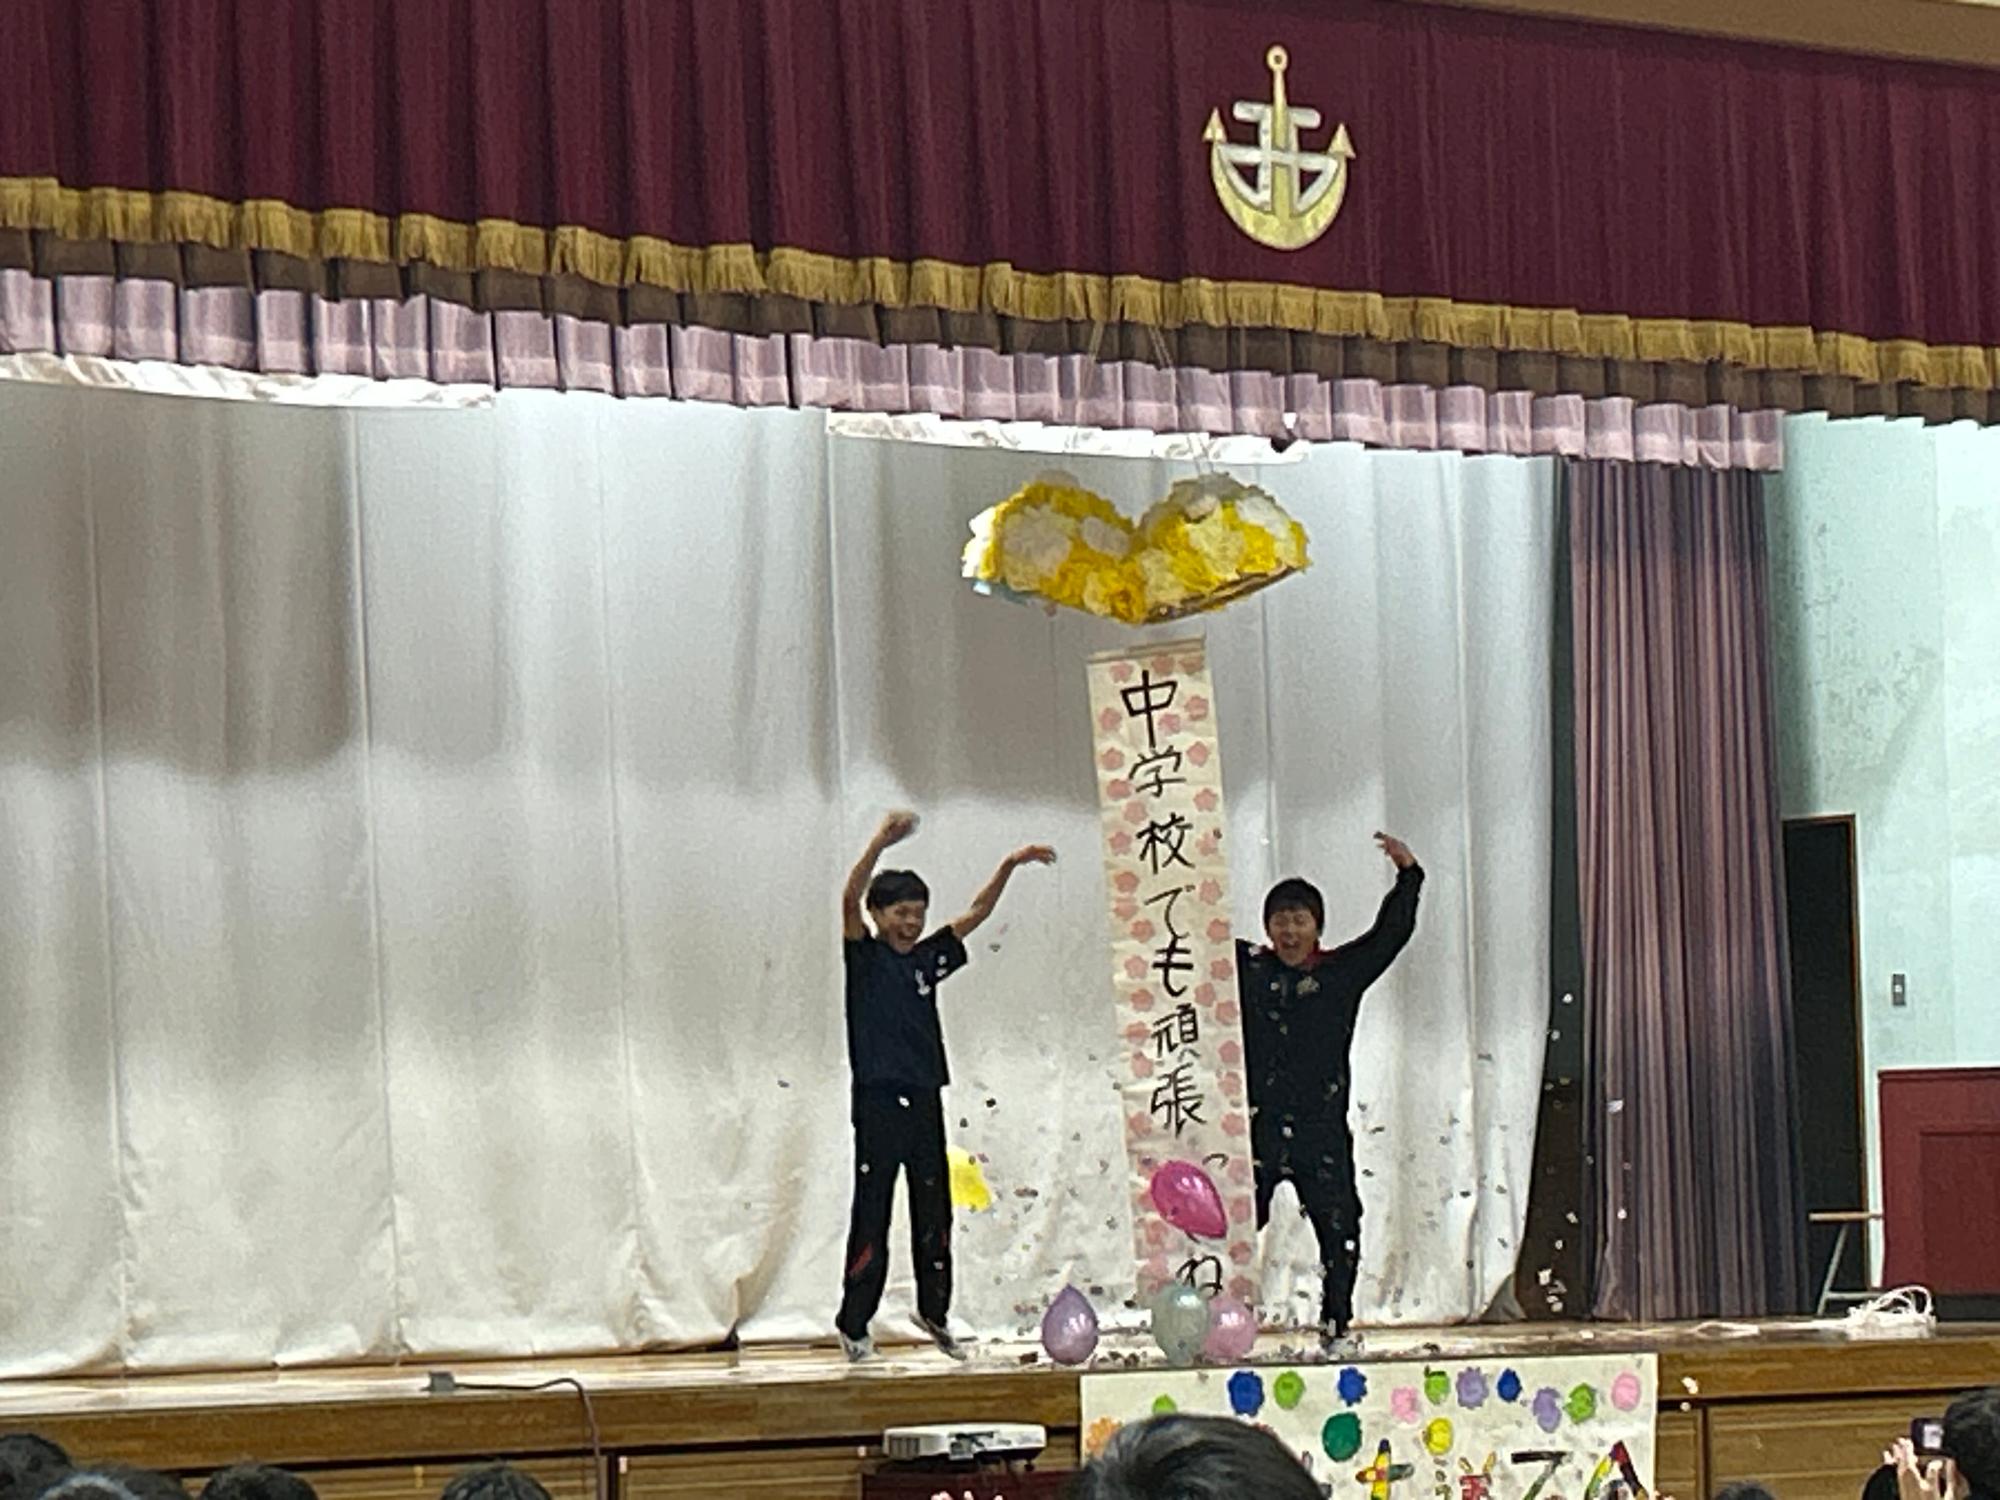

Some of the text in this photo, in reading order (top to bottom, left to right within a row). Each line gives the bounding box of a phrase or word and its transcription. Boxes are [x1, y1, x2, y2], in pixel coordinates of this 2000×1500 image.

[1120, 669, 1228, 1298] 中学校でも頑張っね
